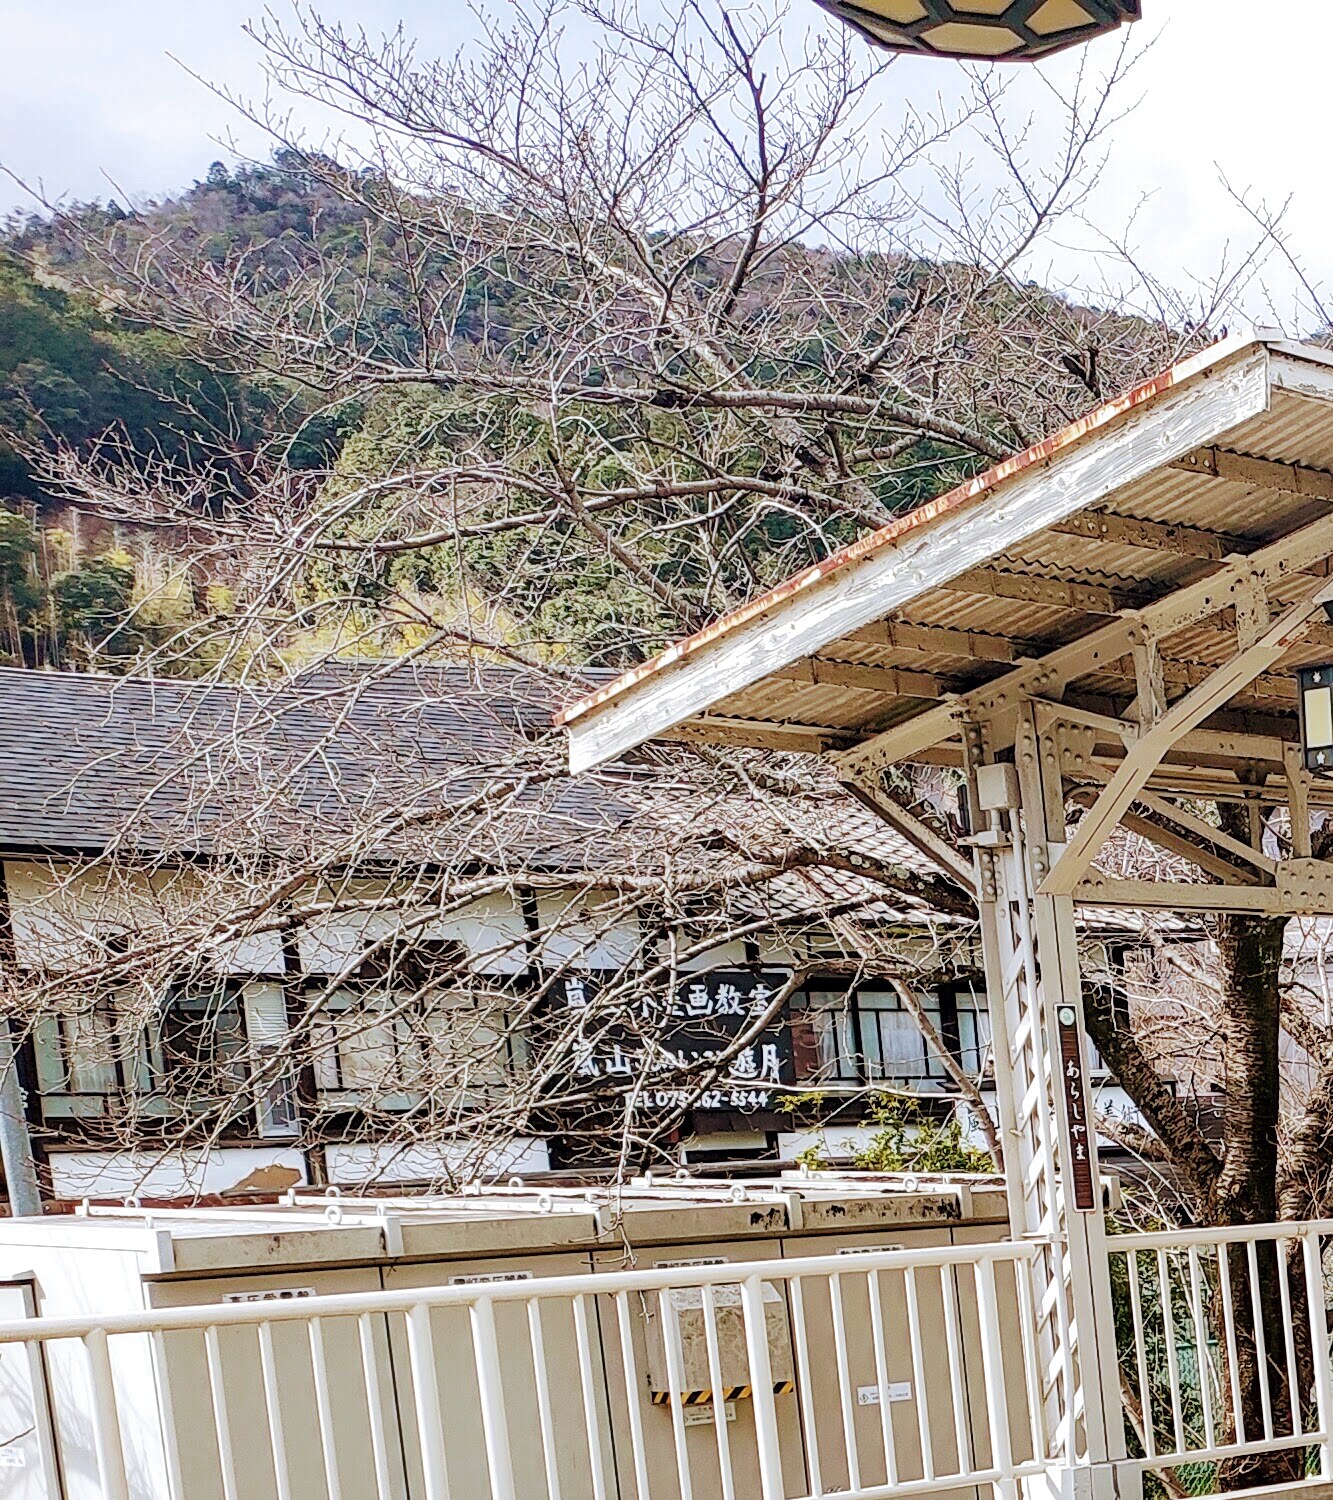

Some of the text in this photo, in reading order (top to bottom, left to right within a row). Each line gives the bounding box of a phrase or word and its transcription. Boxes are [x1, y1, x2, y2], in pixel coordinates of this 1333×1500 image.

[1066, 1059, 1086, 1161] あらしやま
